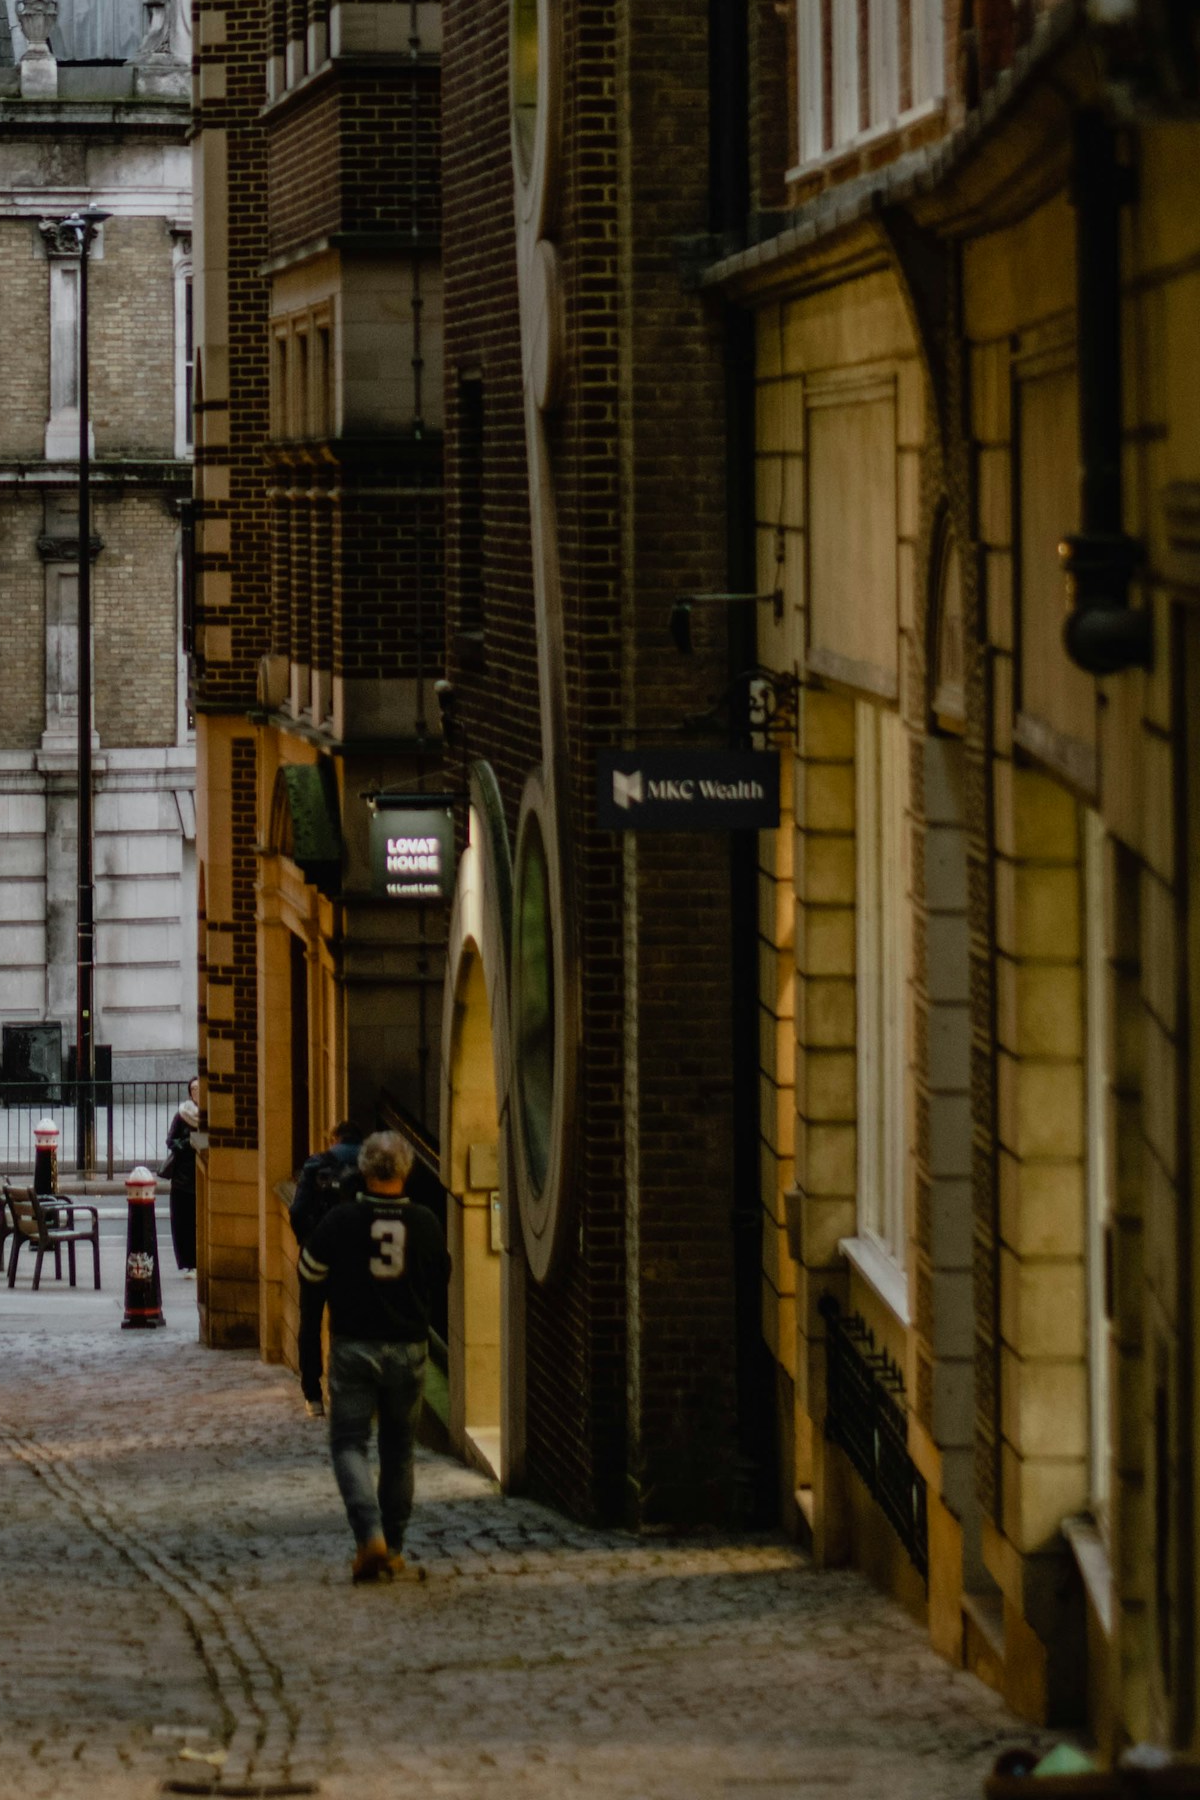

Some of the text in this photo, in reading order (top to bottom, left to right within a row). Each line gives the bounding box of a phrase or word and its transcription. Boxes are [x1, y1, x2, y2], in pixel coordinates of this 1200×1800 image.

[648, 780, 763, 799] MKC Wealth
[387, 838, 438, 854] LOVAT
[387, 855, 439, 872] HOUSE
[370, 1219, 406, 1278] 3
